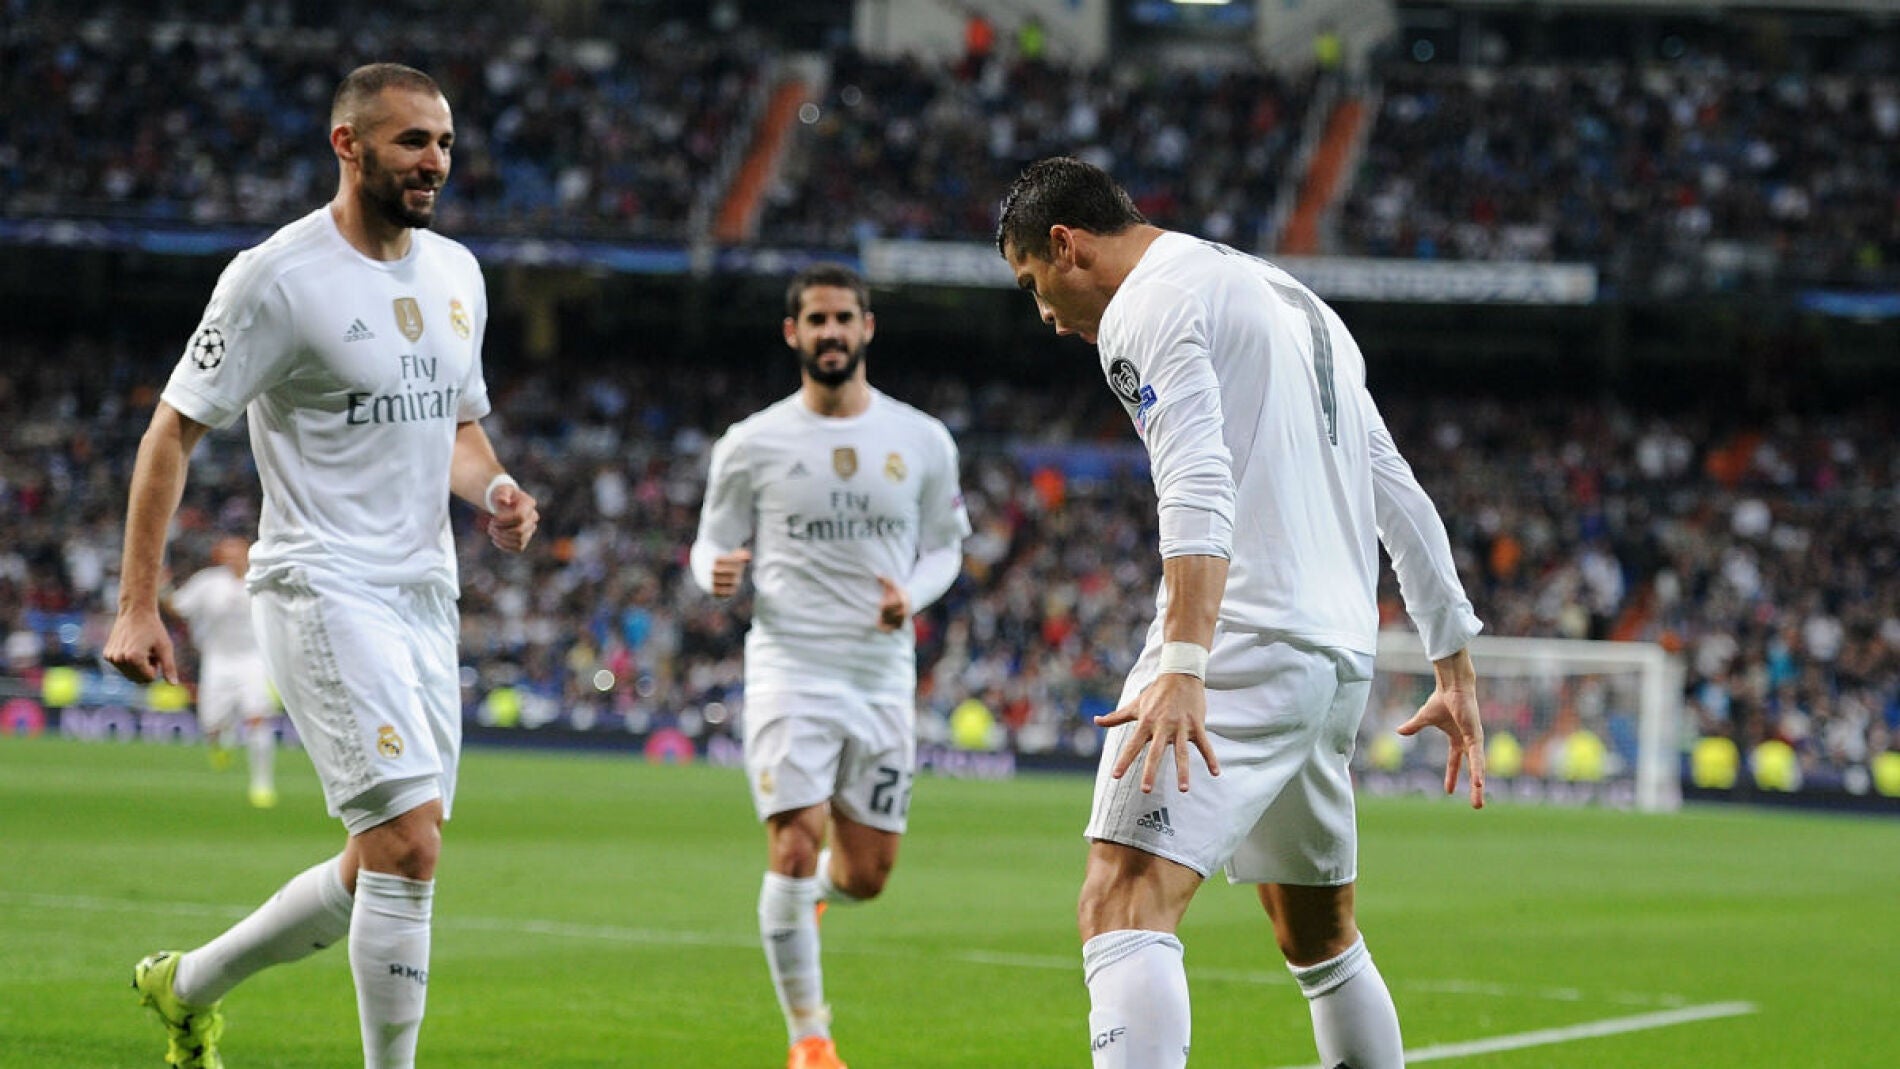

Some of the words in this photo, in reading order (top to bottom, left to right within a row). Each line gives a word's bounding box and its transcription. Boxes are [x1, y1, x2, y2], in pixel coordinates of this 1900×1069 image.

[400, 354, 437, 382] Fly
[1265, 278, 1338, 446] 7
[830, 490, 870, 512] Fly
[1136, 816, 1175, 837] adidas
